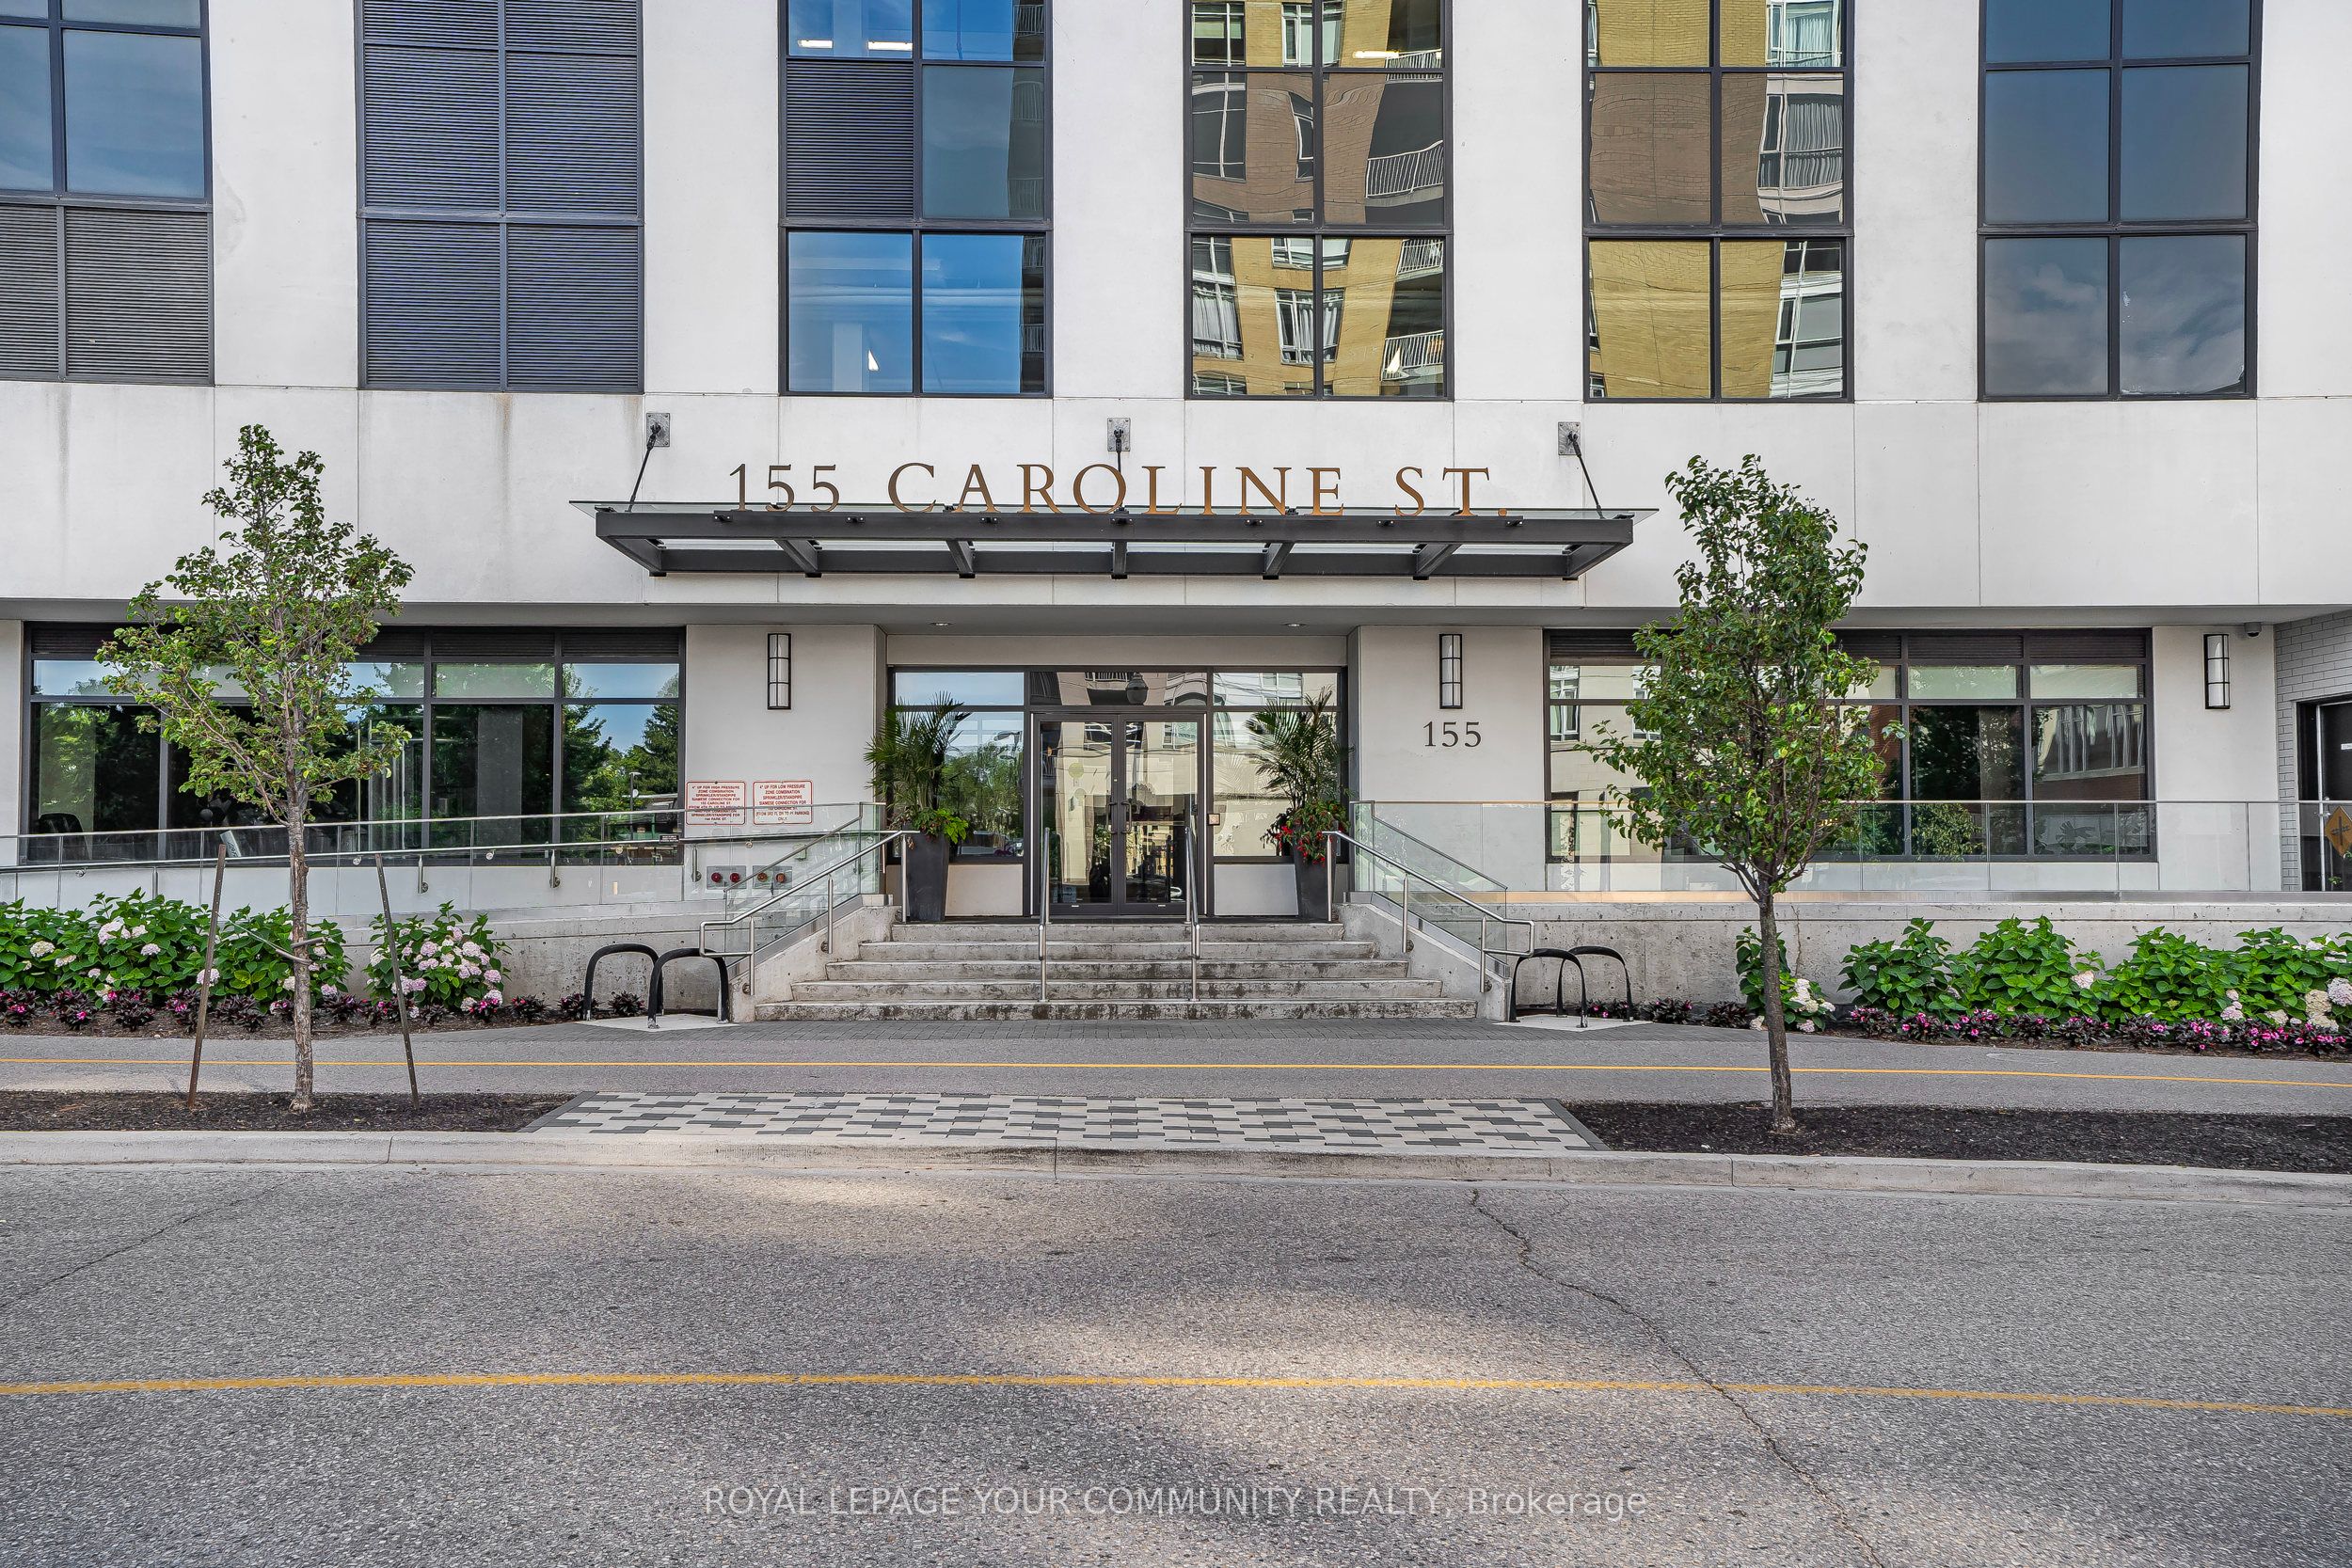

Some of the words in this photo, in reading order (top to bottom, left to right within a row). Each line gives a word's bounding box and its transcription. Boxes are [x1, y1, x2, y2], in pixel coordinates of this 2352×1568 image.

[730, 464, 839, 512] 155
[888, 462, 1344, 516] CAROLINE
[1395, 467, 1507, 516] ST.
[1422, 721, 1482, 748] 155
